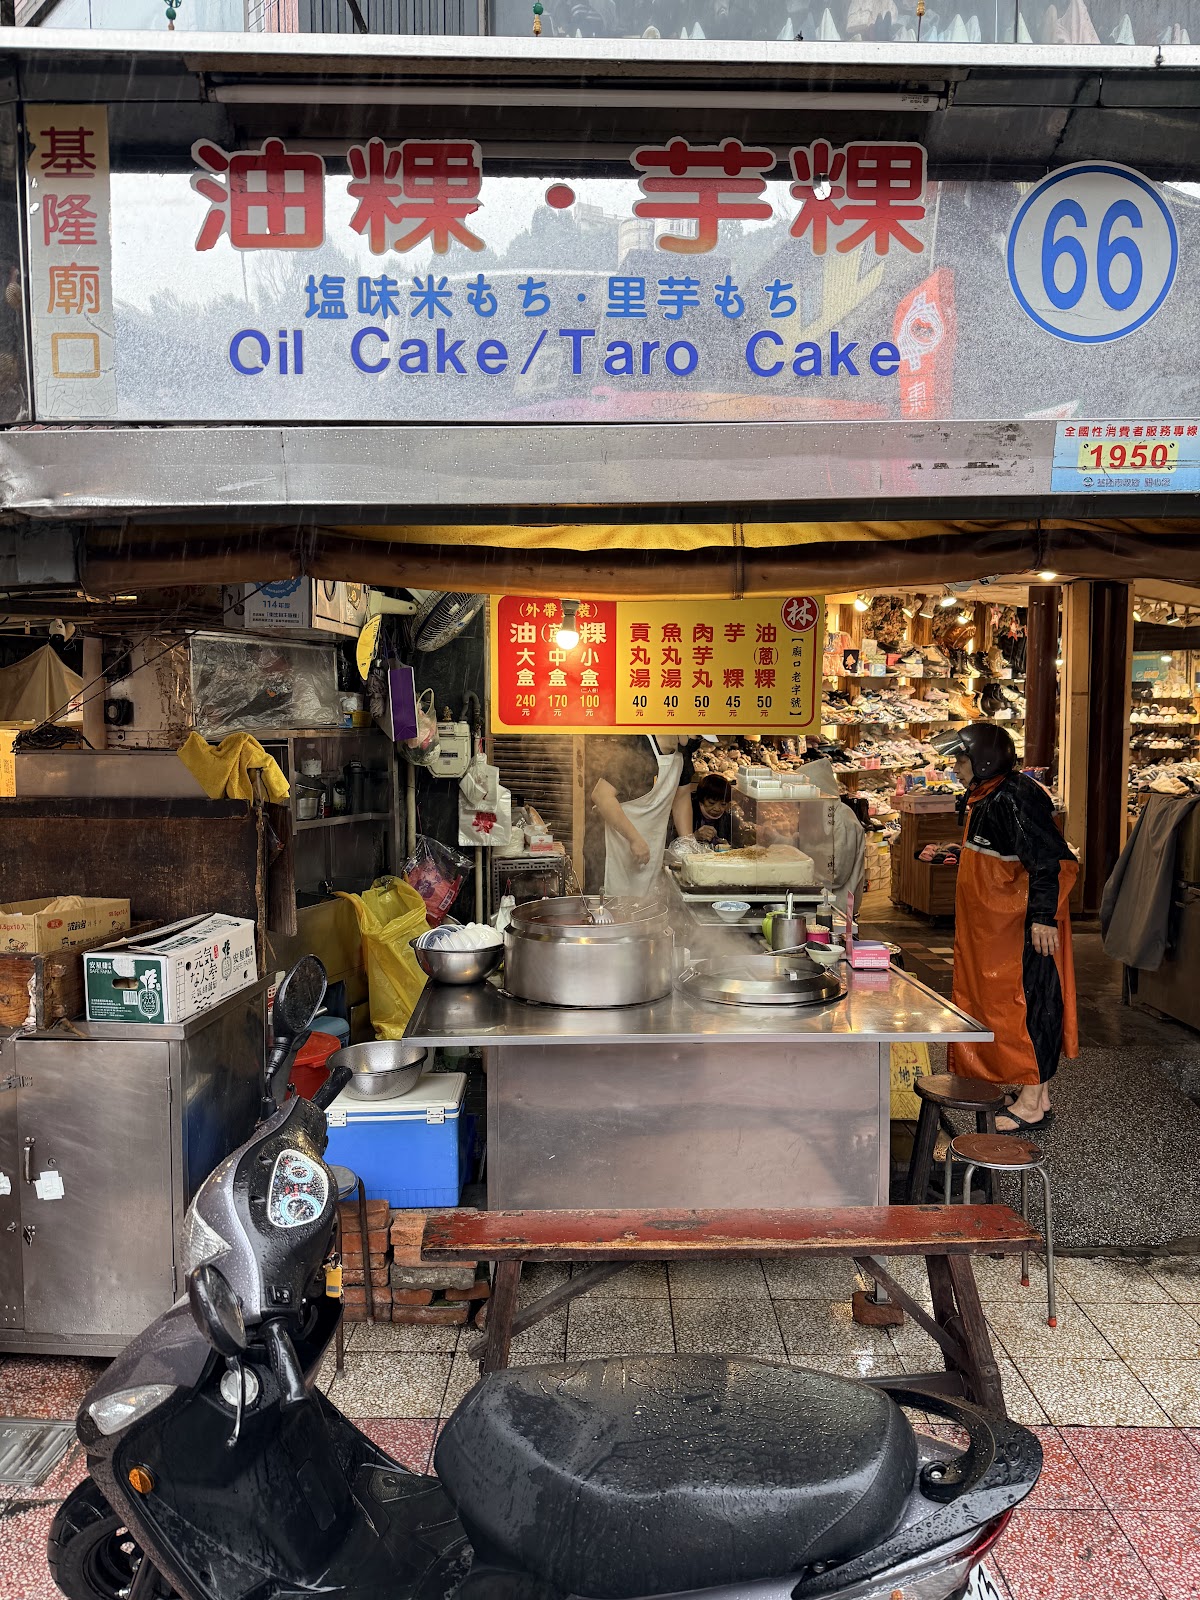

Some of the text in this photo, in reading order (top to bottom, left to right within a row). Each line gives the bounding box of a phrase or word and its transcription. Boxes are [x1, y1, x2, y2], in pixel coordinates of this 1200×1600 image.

[40, 126, 101, 379] 基隆廟口
[1041, 198, 1144, 312] 66
[229, 329, 304, 376] Oil
[745, 329, 901, 377] Cake
[1064, 425, 1199, 438] 全國性消費者服務專線
[1090, 444, 1168, 469] 1950
[519, 602, 598, 618] (外帶裝)
[786, 598, 814, 626] 林
[629, 622, 652, 688] 貢丸湯
[660, 622, 683, 688] 魚丸湯
[691, 622, 714, 689] 肉芋丸
[723, 622, 746, 689] 芋粿
[516, 647, 536, 687] 大盒
[547, 647, 568, 687] 中盒
[580, 647, 600, 687] 小盒
[515, 694, 536, 707] 240
[548, 694, 568, 707] 170
[580, 694, 600, 708] 100
[632, 695, 648, 708] 40
[663, 695, 679, 708] 40
[694, 695, 710, 708] 50
[725, 695, 741, 708] 45
[757, 695, 772, 708] 50
[521, 708, 530, 717] 元
[553, 708, 562, 717] 元
[585, 708, 594, 717] 元
[635, 709, 644, 717] 元
[666, 709, 675, 717] 元
[697, 709, 706, 717] 元
[728, 709, 737, 717] 元
[760, 709, 769, 717] 元
